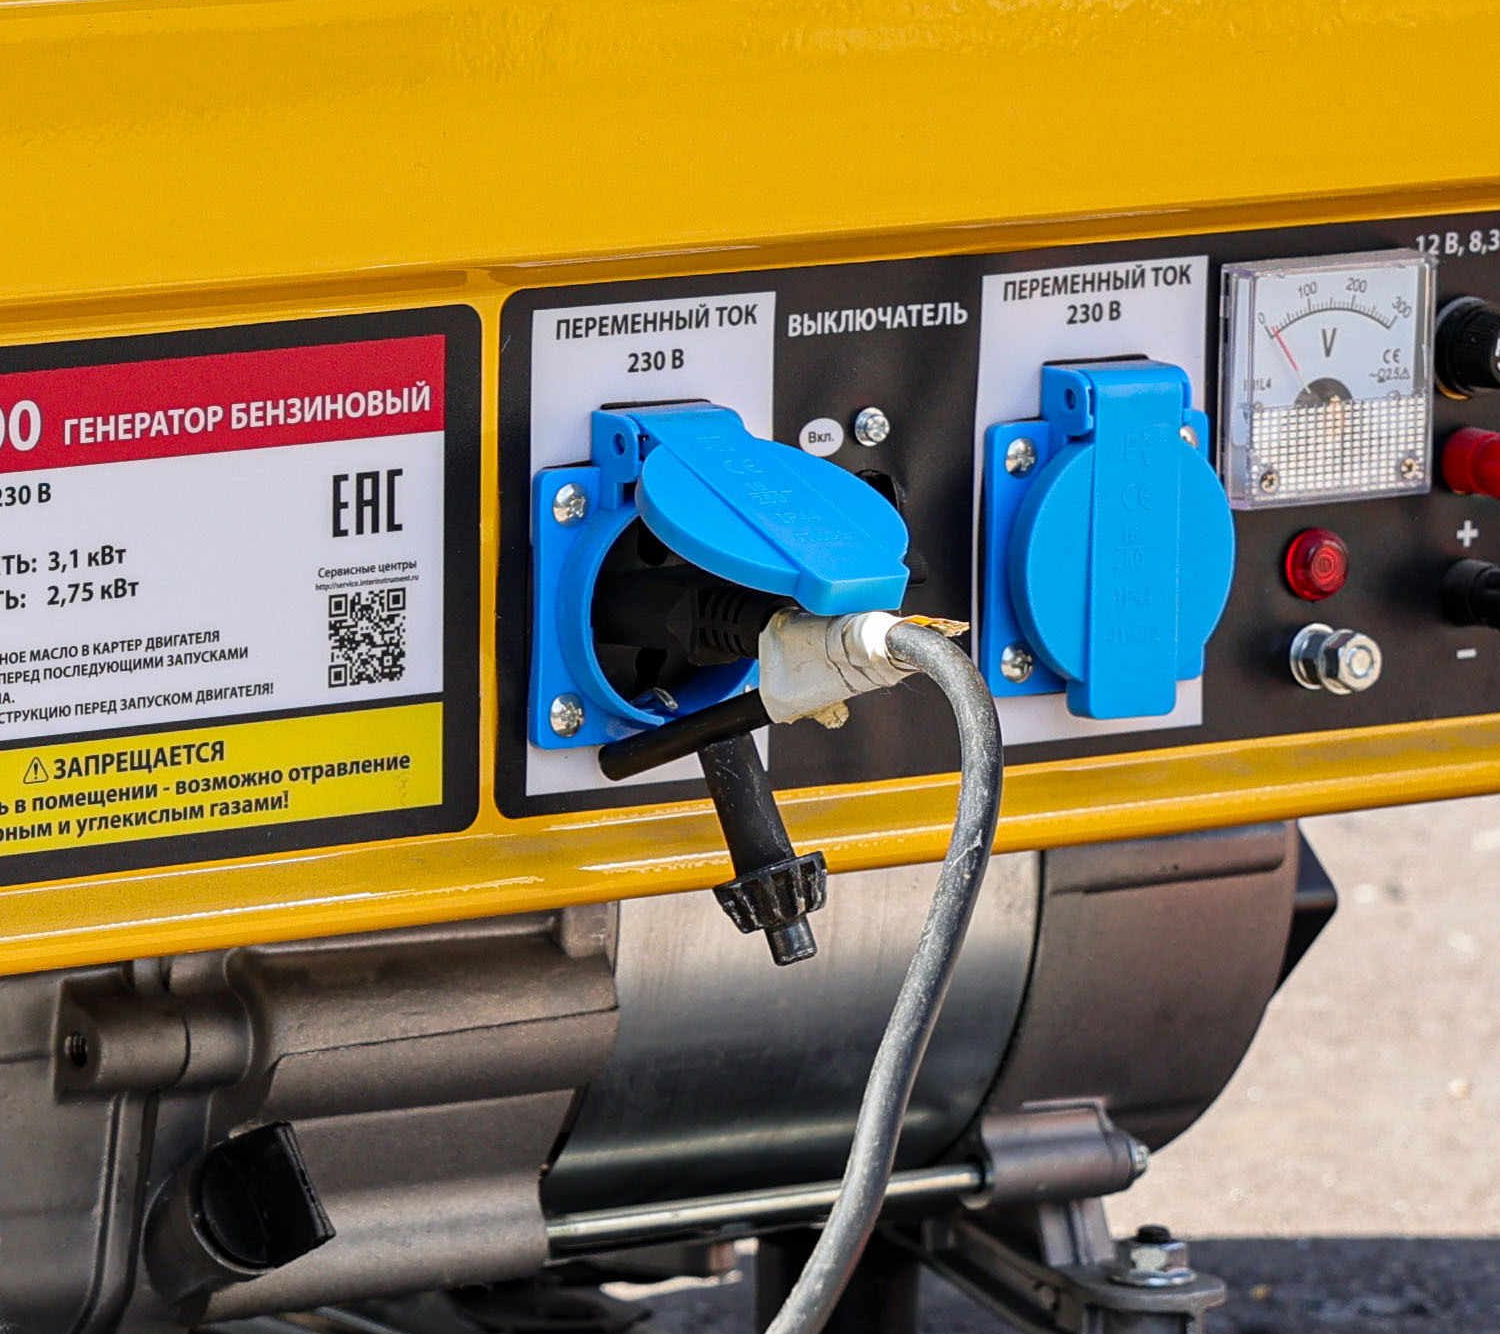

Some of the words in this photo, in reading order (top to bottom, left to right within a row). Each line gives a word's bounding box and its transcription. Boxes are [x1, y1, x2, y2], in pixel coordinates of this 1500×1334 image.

[1414, 234, 1439, 255] 12
[1469, 230, 1500, 254] 8,3
[1003, 264, 1146, 302] ПЕРЕМЕННЫЙ
[1151, 264, 1192, 287] ТОК
[1297, 281, 1318, 299] 100
[1345, 277, 1367, 294] 200
[555, 303, 710, 341] ПЕРЕМЕННЫЙ
[716, 303, 758, 328] ТОК
[788, 302, 969, 338] ВЫКЛЮЧАТЕЛЬ
[1066, 302, 1103, 325] 230
[1109, 300, 1121, 321] В
[1258, 311, 1267, 325] 0
[1391, 296, 1412, 318] 300
[1321, 327, 1337, 358] V
[627, 351, 665, 373] 230
[671, 348, 685, 369] В
[62, 405, 224, 446] ГЕНЕРАТОР
[230, 380, 431, 430] БЕНЗИНОВЫЙ
[808, 430, 835, 444] Вкл.
[37, 482, 52, 503] В
[48, 549, 80, 574] 3,1
[87, 544, 127, 567] кВт
[317, 564, 376, 579] Сервисные
[378, 560, 418, 574] центры
[47, 582, 94, 608] 2,75
[101, 577, 139, 600] кВт
[29, 645, 78, 663] МАСЛО
[81, 644, 90, 656] В
[93, 638, 142, 655] КАРТЕР
[145, 630, 220, 651] ДВИГАТЕЛЯ
[43, 657, 164, 681] ПОСЛЕДУЮЩИМИ
[167, 646, 249, 668] ЗАПУСКАМИ
[74, 699, 117, 717] ПЕРЕД
[120, 691, 193, 710] ЗАПУСКОМ
[195, 682, 274, 703] ДВИГАТЕЛЯ!
[53, 740, 225, 780] ЗАПРЕЩАЕТСЯ
[15, 799, 27, 814] в
[32, 781, 158, 812] помещении
[175, 768, 283, 796] возможно
[288, 754, 411, 785] отравление
[58, 820, 70, 835] и
[77, 803, 204, 838] углекислым
[210, 790, 289, 817] газами!
